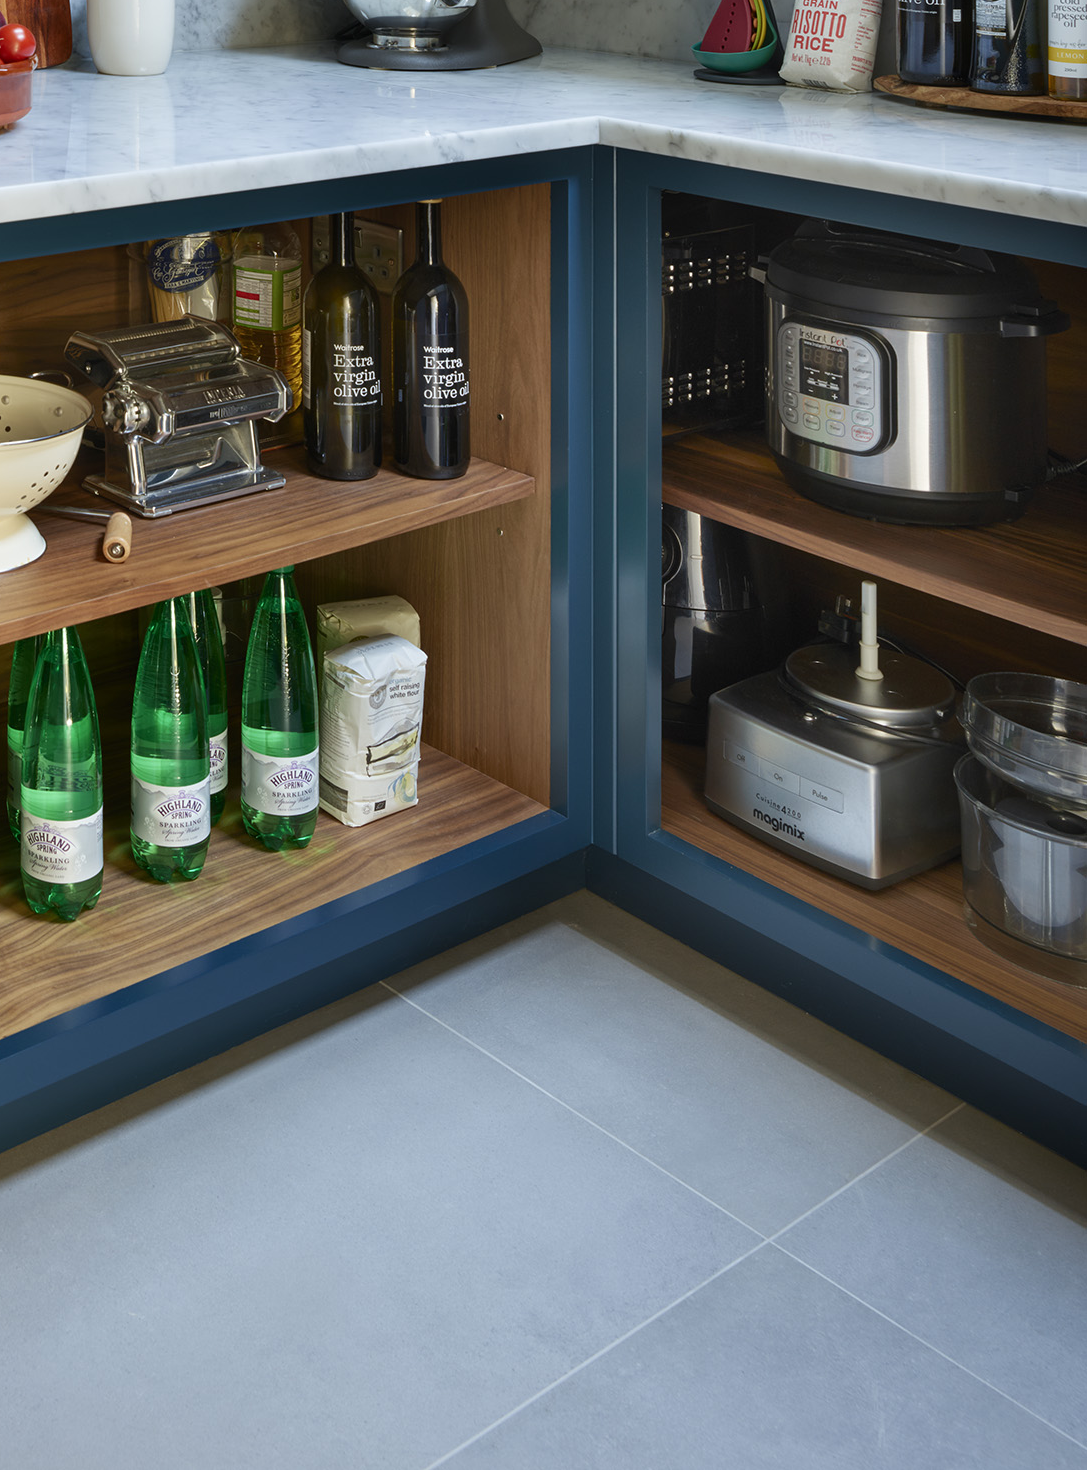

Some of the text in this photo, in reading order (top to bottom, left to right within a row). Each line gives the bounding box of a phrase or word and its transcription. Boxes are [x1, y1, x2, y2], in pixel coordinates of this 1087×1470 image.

[1053, 4, 1087, 13] pressed
[1051, 11, 1087, 22] rapesee
[1063, 19, 1077, 28] oil
[791, 9, 848, 39] RISOTTO
[793, 35, 835, 53] RICE
[1056, 52, 1085, 60] LEMON
[799, 328, 846, 347] Instant Pot
[333, 343, 365, 352] Waitrose
[423, 345, 454, 354] Waitrose
[333, 353, 375, 368] Extra
[423, 355, 464, 370] Extra
[333, 369, 376, 386] virgin
[423, 371, 466, 387] virgin
[333, 379, 381, 398] olive oil
[423, 381, 470, 400] olive oil
[388, 682, 421, 693] self raising
[389, 689, 420, 700] white flour
[736, 753, 746, 762] Off
[270, 769, 314, 787] HIGHLAND
[773, 772, 784, 783] On
[283, 780, 304, 790] SPRING
[271, 787, 314, 798] SPARKLING
[811, 788, 829, 802] Pulse
[157, 799, 202, 817] HIGHLAND
[159, 818, 202, 828] SPARKLING
[171, 812, 192, 820] SPRING
[753, 807, 805, 841] magimix
[26, 832, 71, 853] HIGHLAND
[36, 844, 58, 855] SPRING
[27, 849, 70, 864] SPARKLING
[29, 858, 50, 872] Spring
